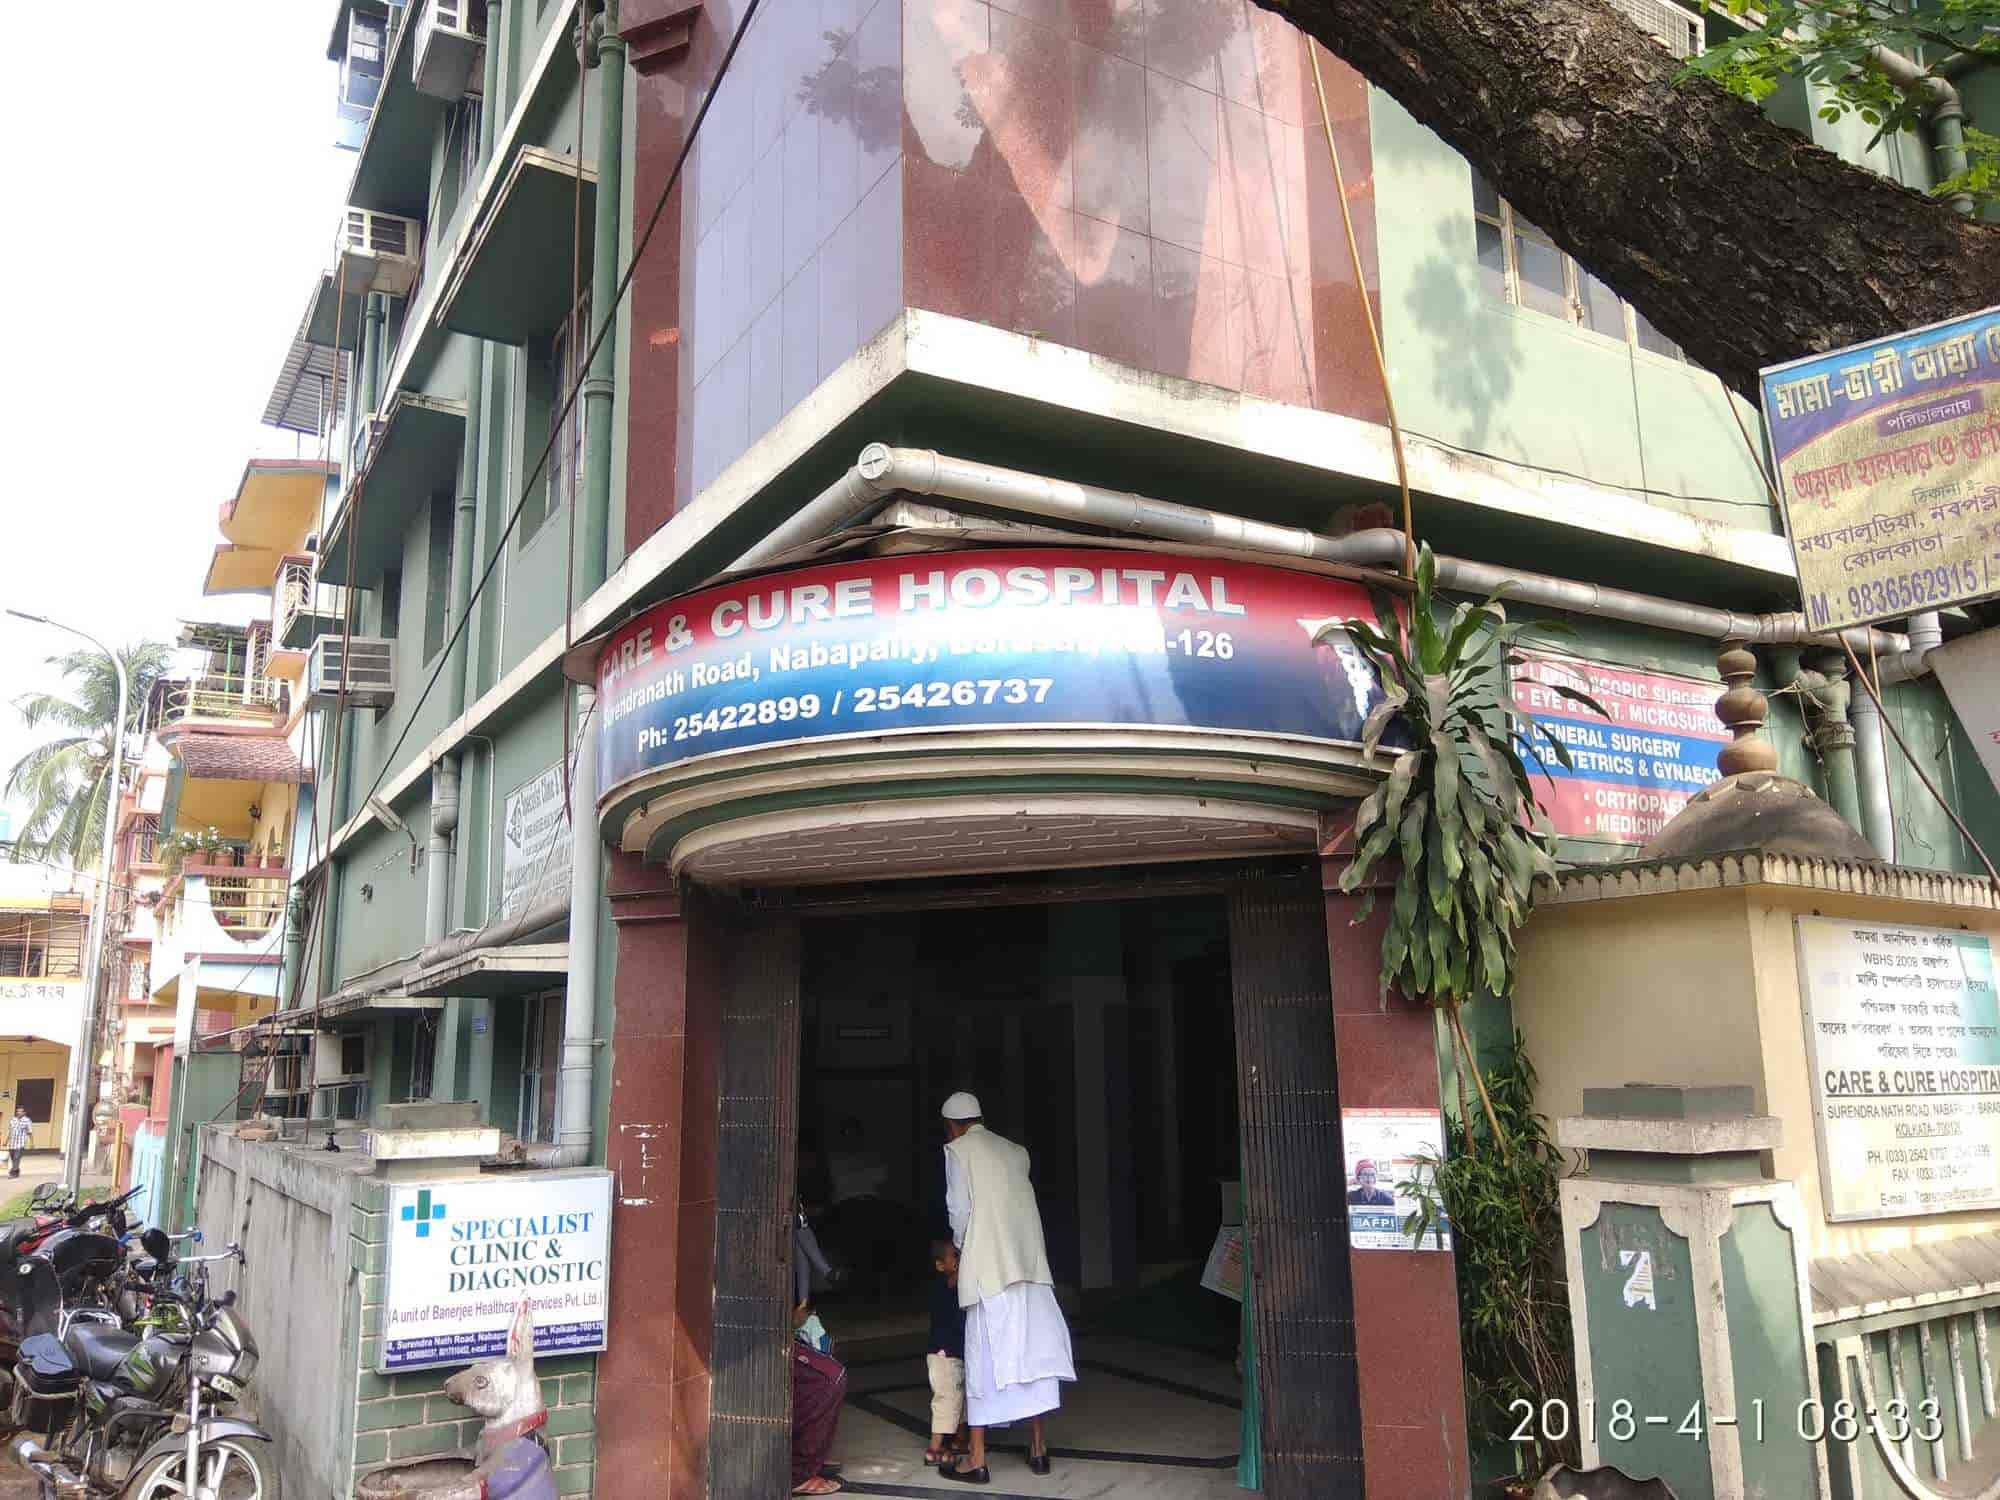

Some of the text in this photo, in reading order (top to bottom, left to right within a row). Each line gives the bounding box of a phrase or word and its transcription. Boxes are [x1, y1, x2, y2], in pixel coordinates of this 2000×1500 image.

[602, 566, 1246, 690] CARE & CURE HOSPITAL
[692, 650, 761, 689] Road,
[1530, 687, 1562, 710] EYE
[638, 727, 669, 753] Ph:
[674, 693, 820, 742] 25422899
[854, 677, 1056, 713] 25426737
[1532, 744, 1634, 775] OBTETRICS
[1638, 758, 1650, 777] &
[1611, 732, 1682, 759] SURGERY
[1825, 1070, 1874, 1093] CARE
[1878, 1070, 1890, 1093] &
[1894, 1070, 1937, 1093] CURE
[450, 1211, 594, 1242] SPECIALIST
[450, 1238, 562, 1266] CLINIC &
[449, 1260, 602, 1292] DIAGNOSTIC
[400, 1306, 418, 1323] unit
[420, 1304, 431, 1320] of
[432, 1301, 473, 1321] Banerjee
[475, 1298, 522, 1315] Healthcar
